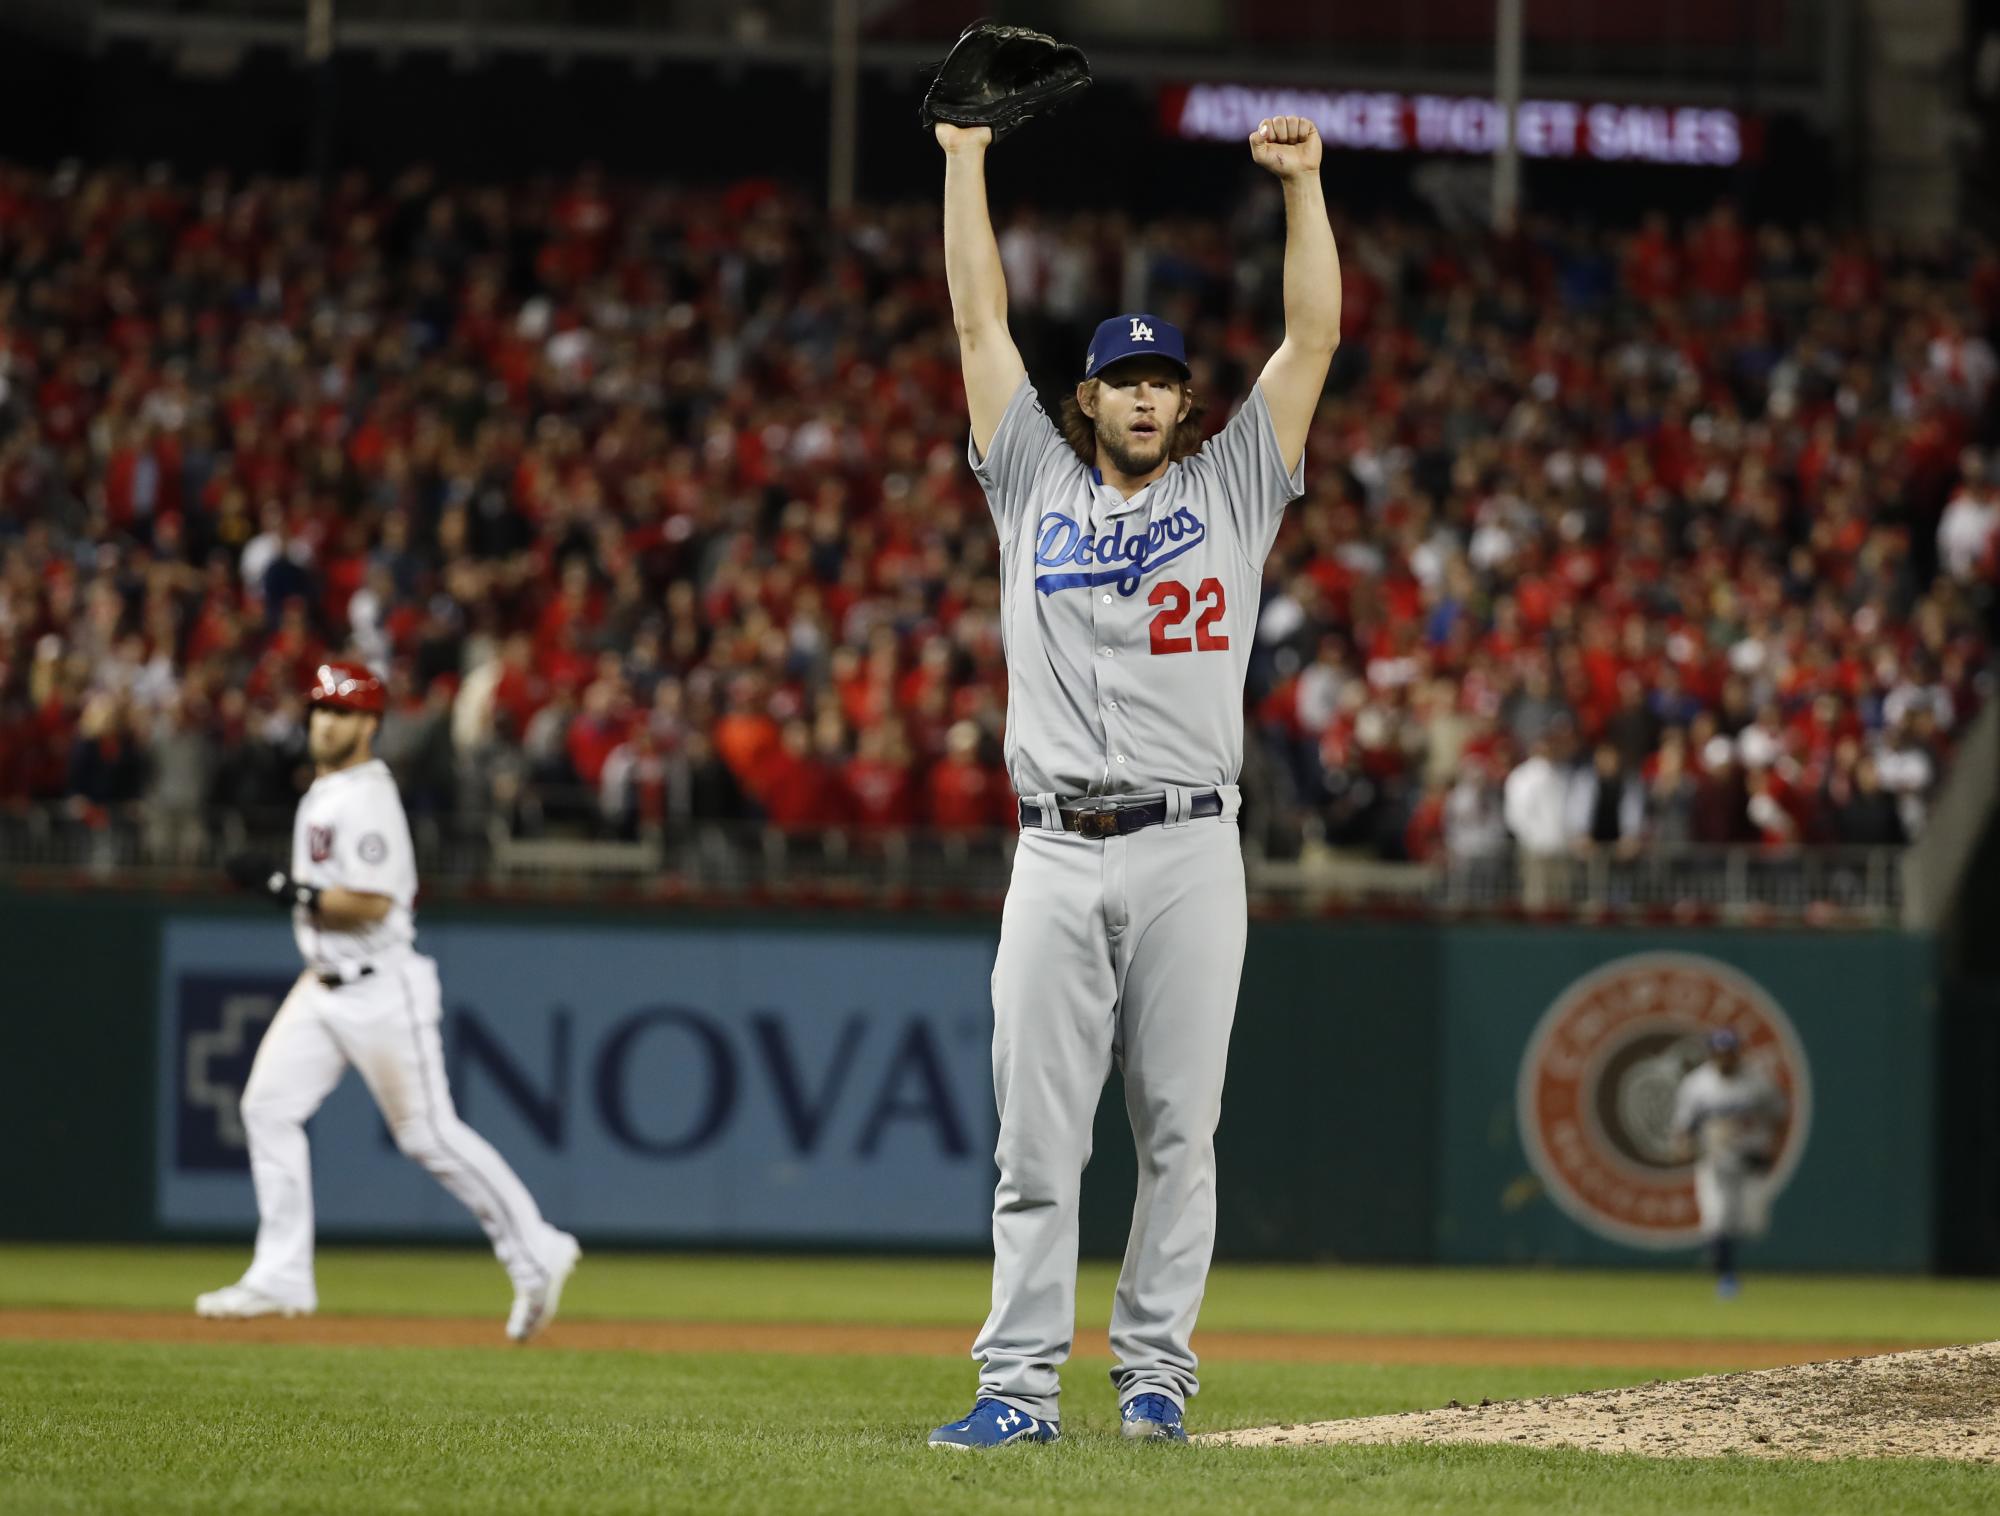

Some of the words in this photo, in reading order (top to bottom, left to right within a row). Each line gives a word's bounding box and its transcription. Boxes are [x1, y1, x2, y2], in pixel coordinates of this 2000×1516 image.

[1588, 103, 1741, 165] SALES
[1129, 318, 1155, 342] LA
[1035, 506, 1205, 597] Dodgers
[1148, 577, 1230, 656] 22
[378, 1002, 974, 1160] NOVA
